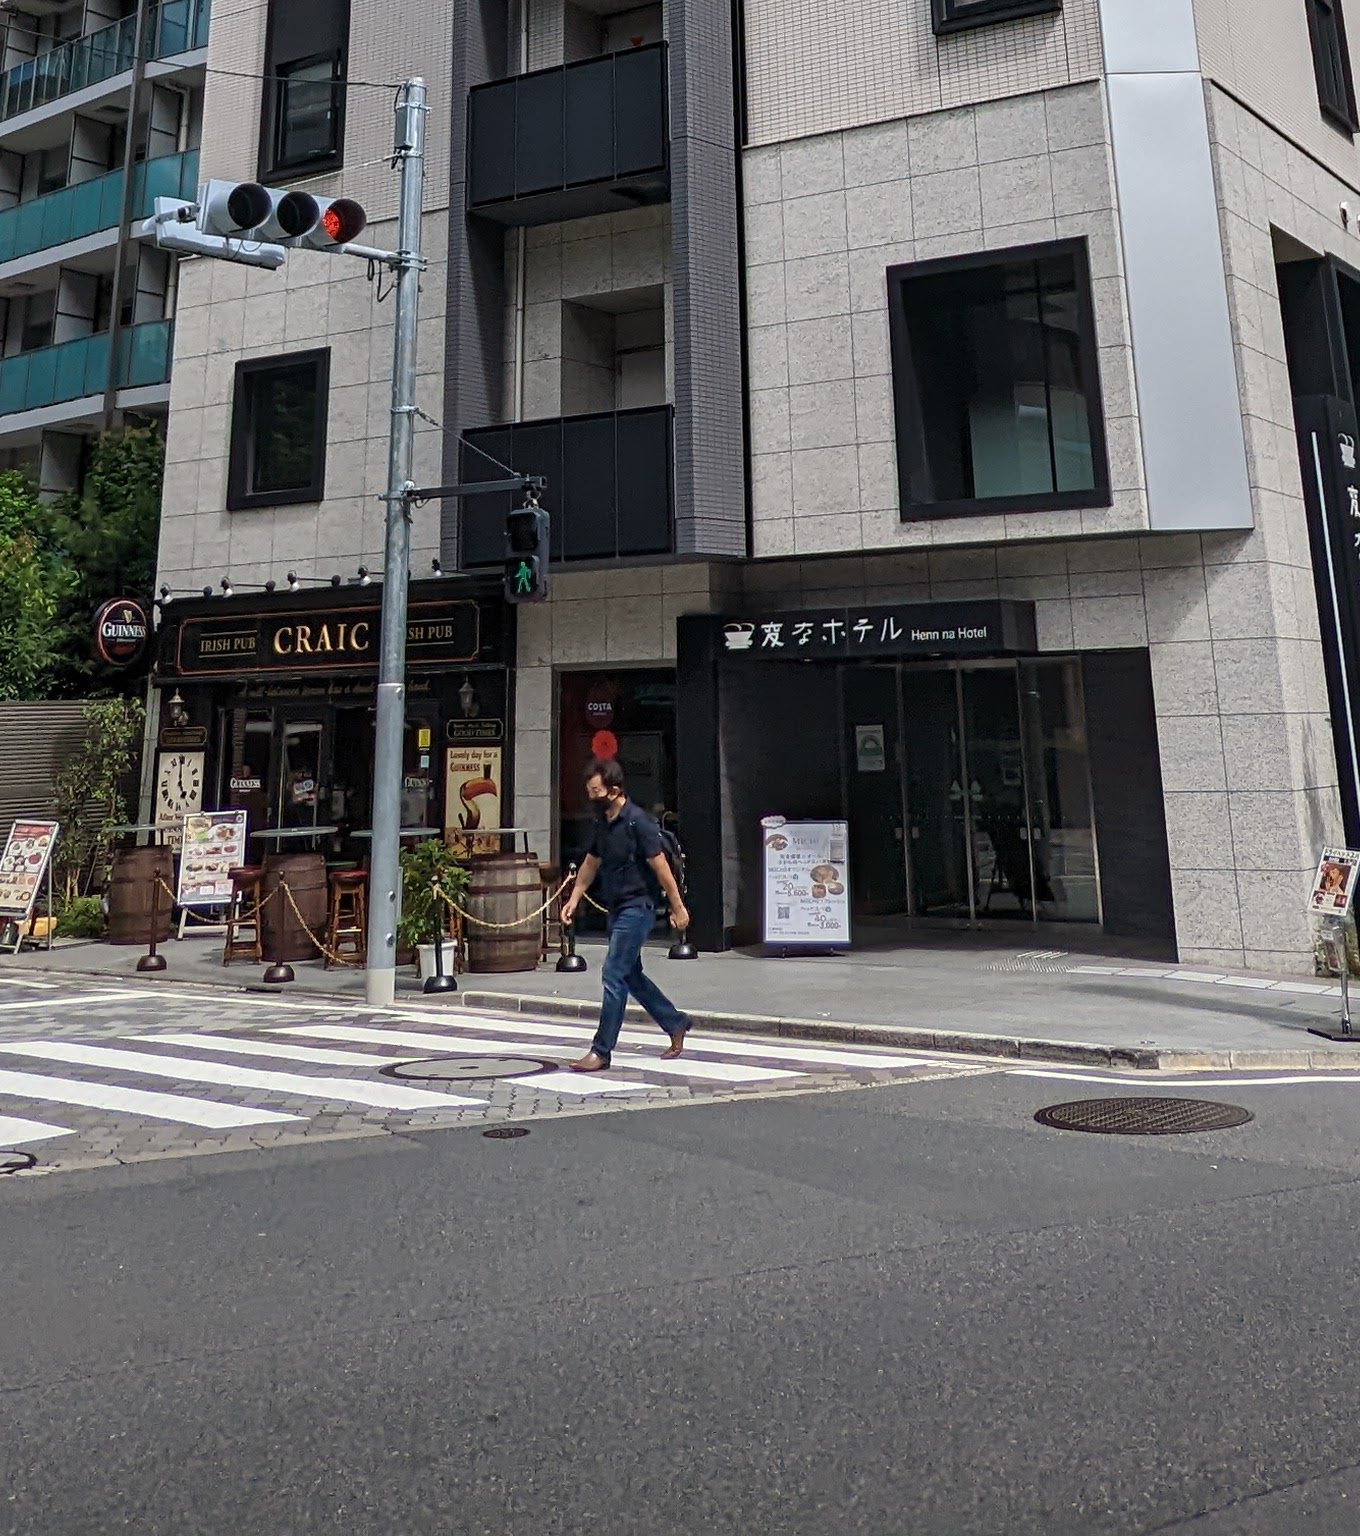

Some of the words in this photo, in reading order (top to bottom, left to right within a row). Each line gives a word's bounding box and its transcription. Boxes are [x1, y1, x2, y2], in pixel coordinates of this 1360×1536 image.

[103, 622, 146, 637] GUINNESS
[428, 625, 452, 639] PUB
[761, 617, 903, 648] 変なホテル
[911, 629, 939, 641] Henn
[942, 631, 955, 640] na
[958, 626, 987, 639] Hotel
[200, 639, 230, 652] IRISH
[234, 637, 256, 650] PUB
[273, 622, 369, 655] CRAIC
[588, 703, 612, 711] COSTA
